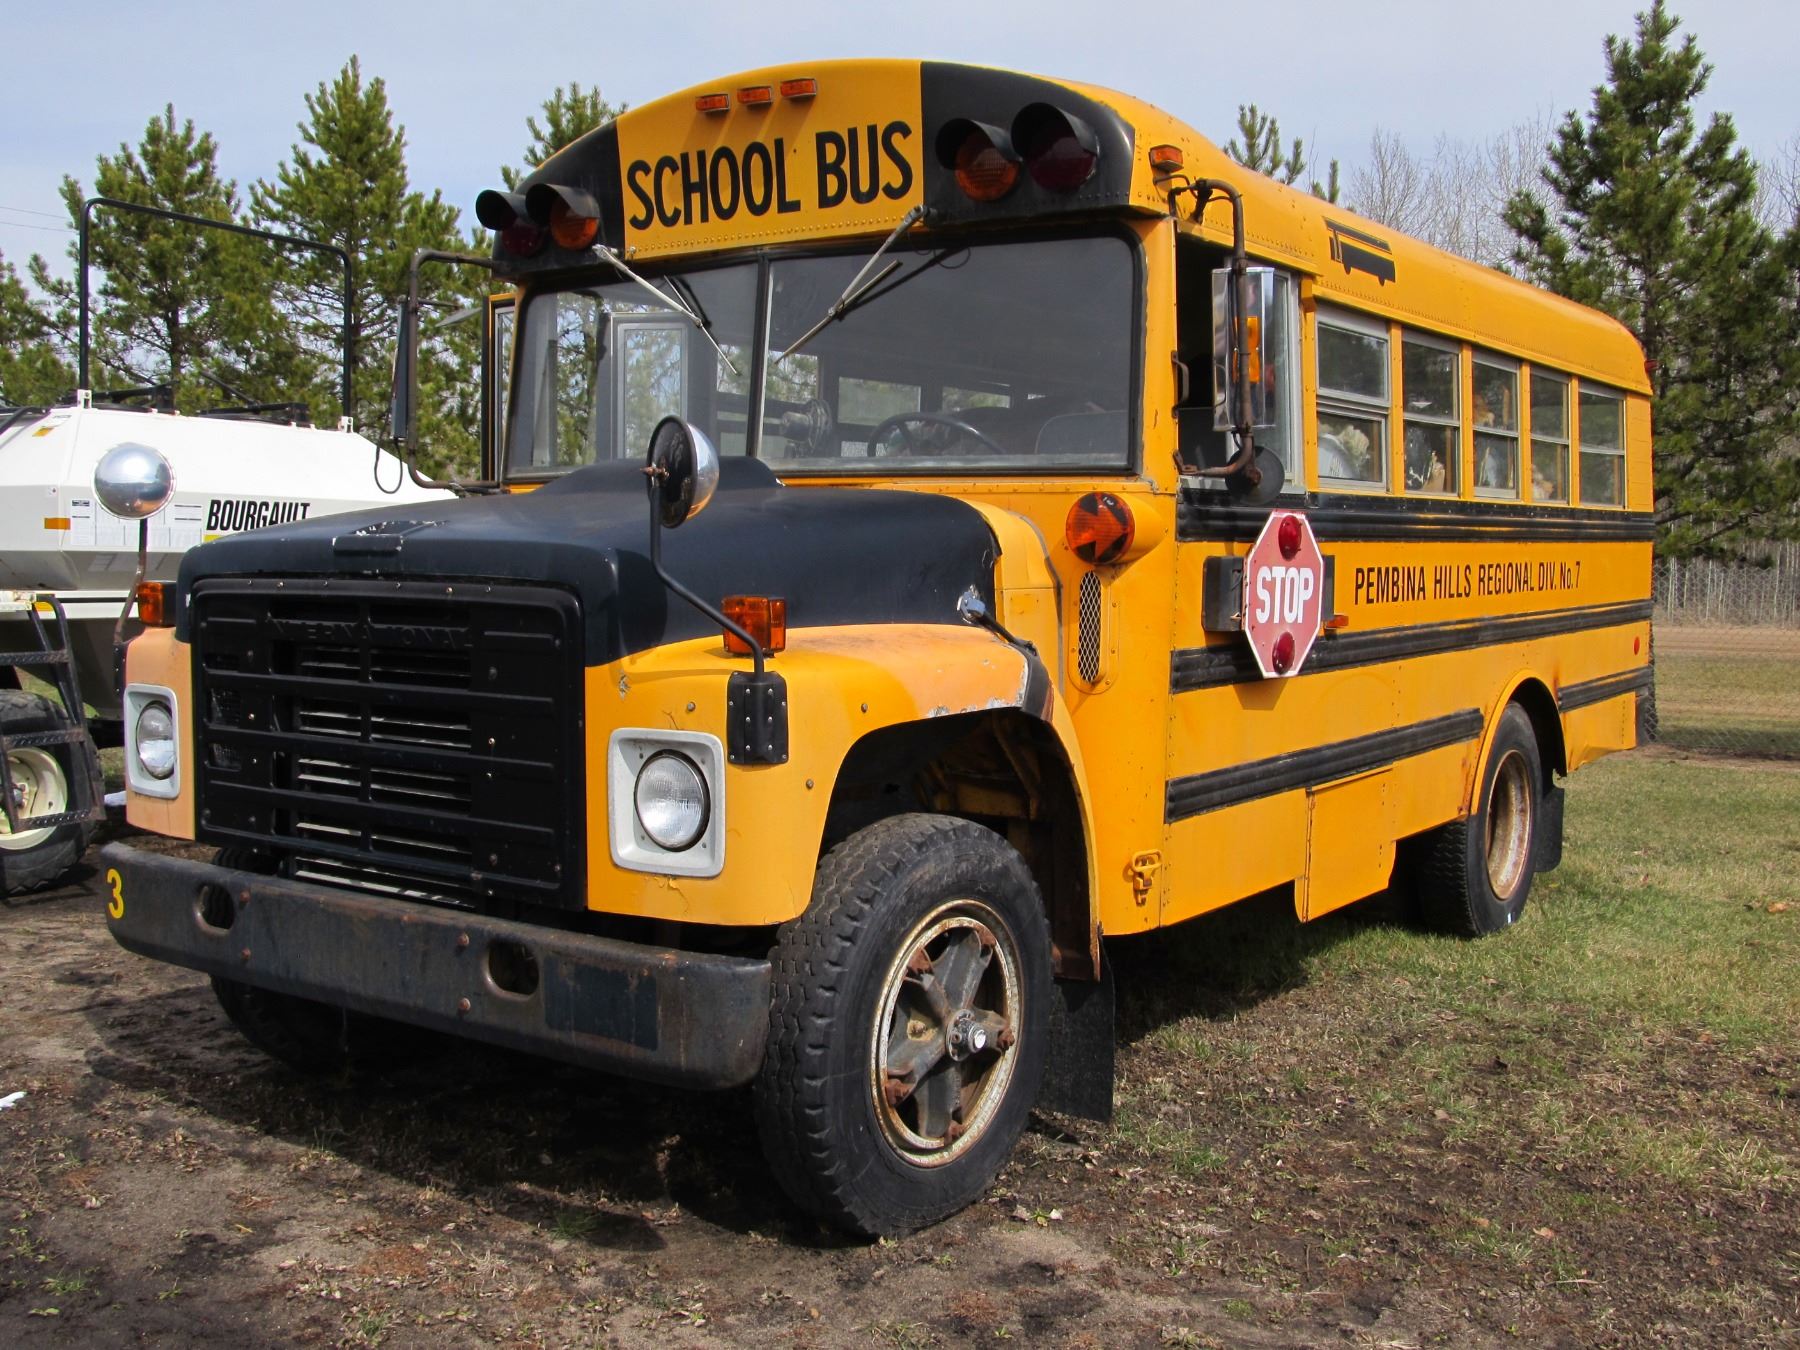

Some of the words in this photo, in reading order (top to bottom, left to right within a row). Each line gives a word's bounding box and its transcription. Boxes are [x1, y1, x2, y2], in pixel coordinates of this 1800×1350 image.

[627, 137, 801, 231] SCHOOL
[815, 120, 913, 209] BUS
[1256, 566, 1314, 624] STOP
[1354, 566, 1426, 605] PEMBINA
[1434, 564, 1472, 599] HILLS
[1478, 561, 1535, 596] REGIONAL
[1538, 561, 1557, 591] DIV.
[1576, 560, 1581, 588] 7
[107, 868, 124, 919] 3
